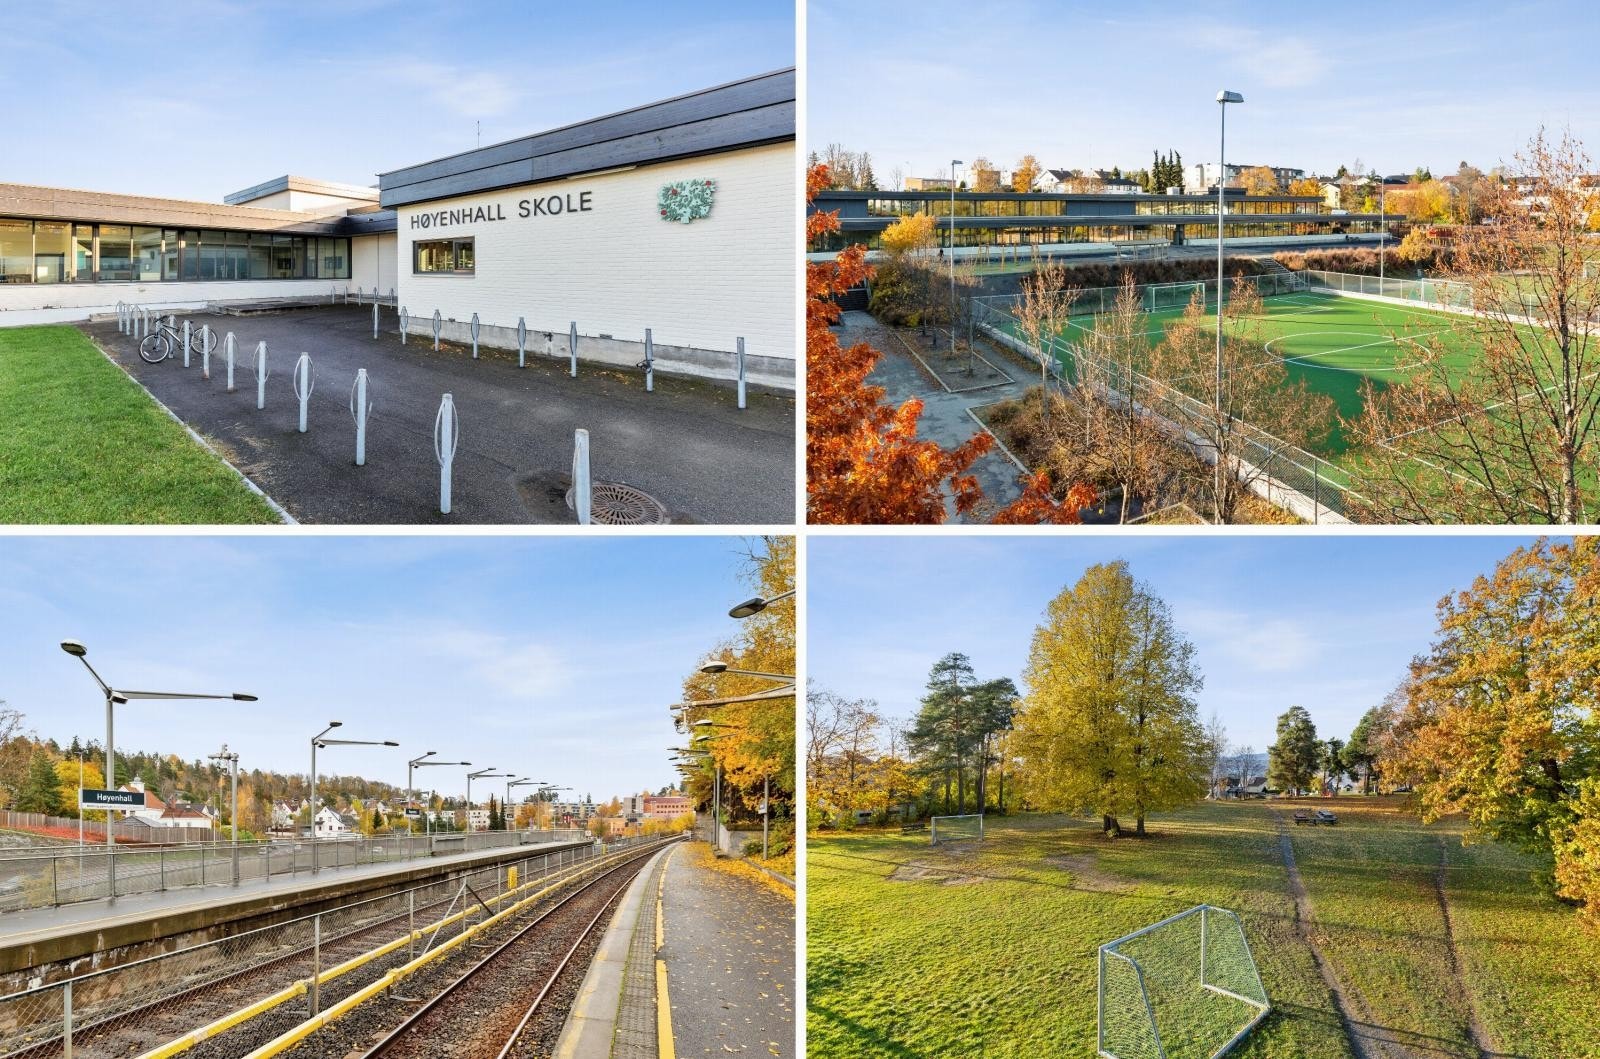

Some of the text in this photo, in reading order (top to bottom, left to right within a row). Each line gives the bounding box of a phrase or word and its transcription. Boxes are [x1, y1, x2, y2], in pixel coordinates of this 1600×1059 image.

[410, 191, 593, 230] HØYENHALL SKOLE
[96, 793, 133, 802] Høyenhall
